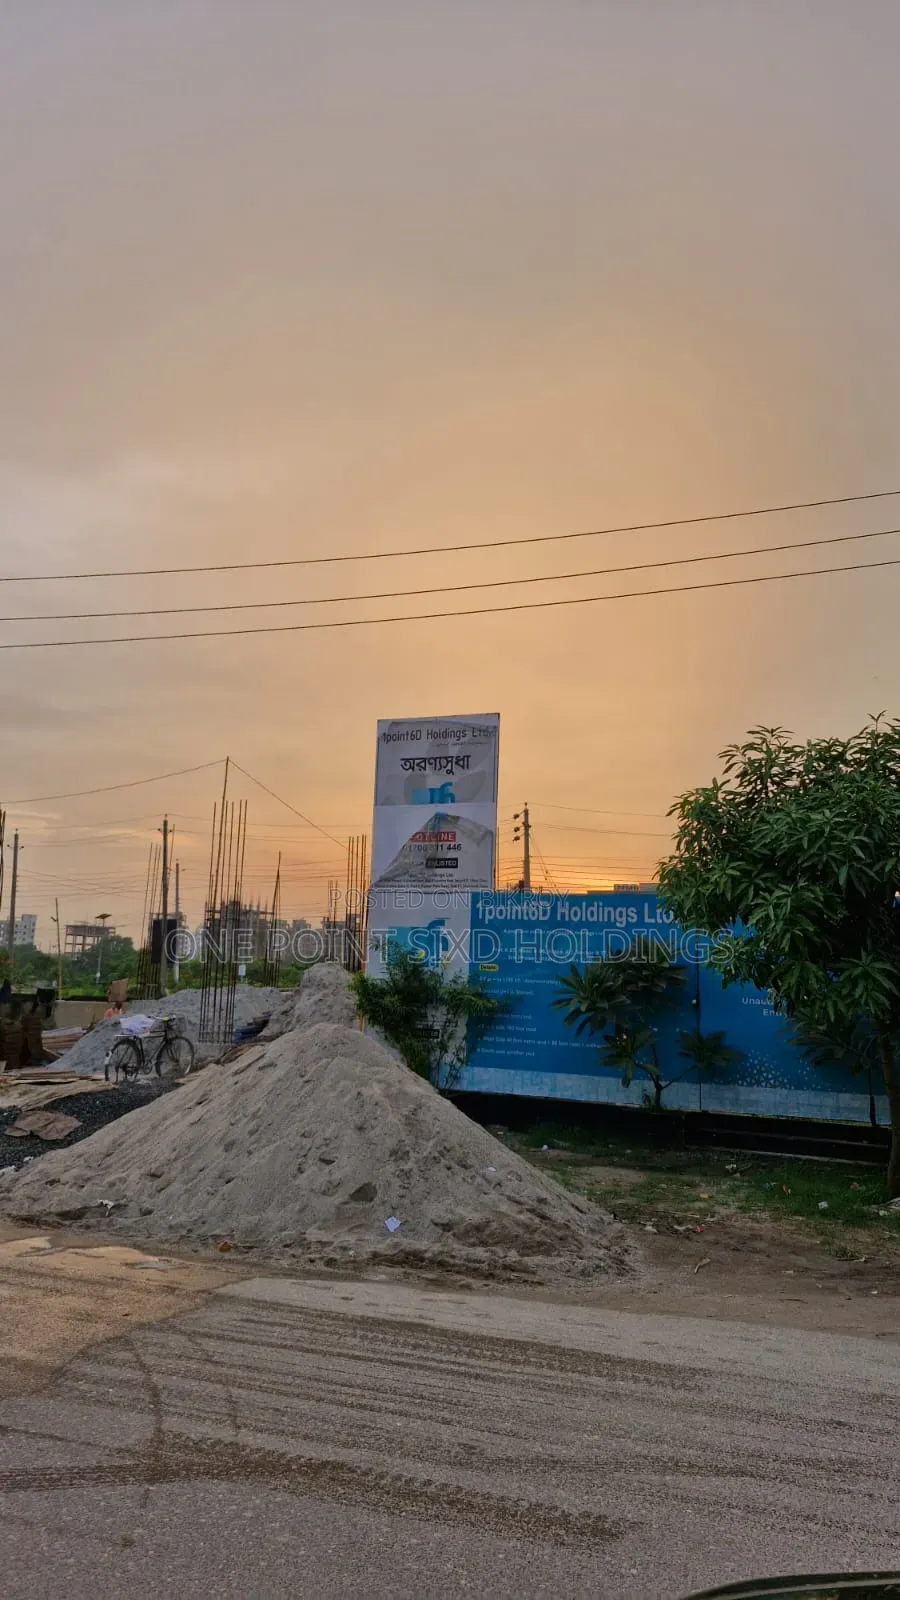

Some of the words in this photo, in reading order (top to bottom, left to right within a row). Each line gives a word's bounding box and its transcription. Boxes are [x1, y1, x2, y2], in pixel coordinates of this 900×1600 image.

[427, 728, 467, 741] Holdings
[400, 755, 471, 775] অরণ্যসুধা
[557, 901, 638, 927] Holdings
